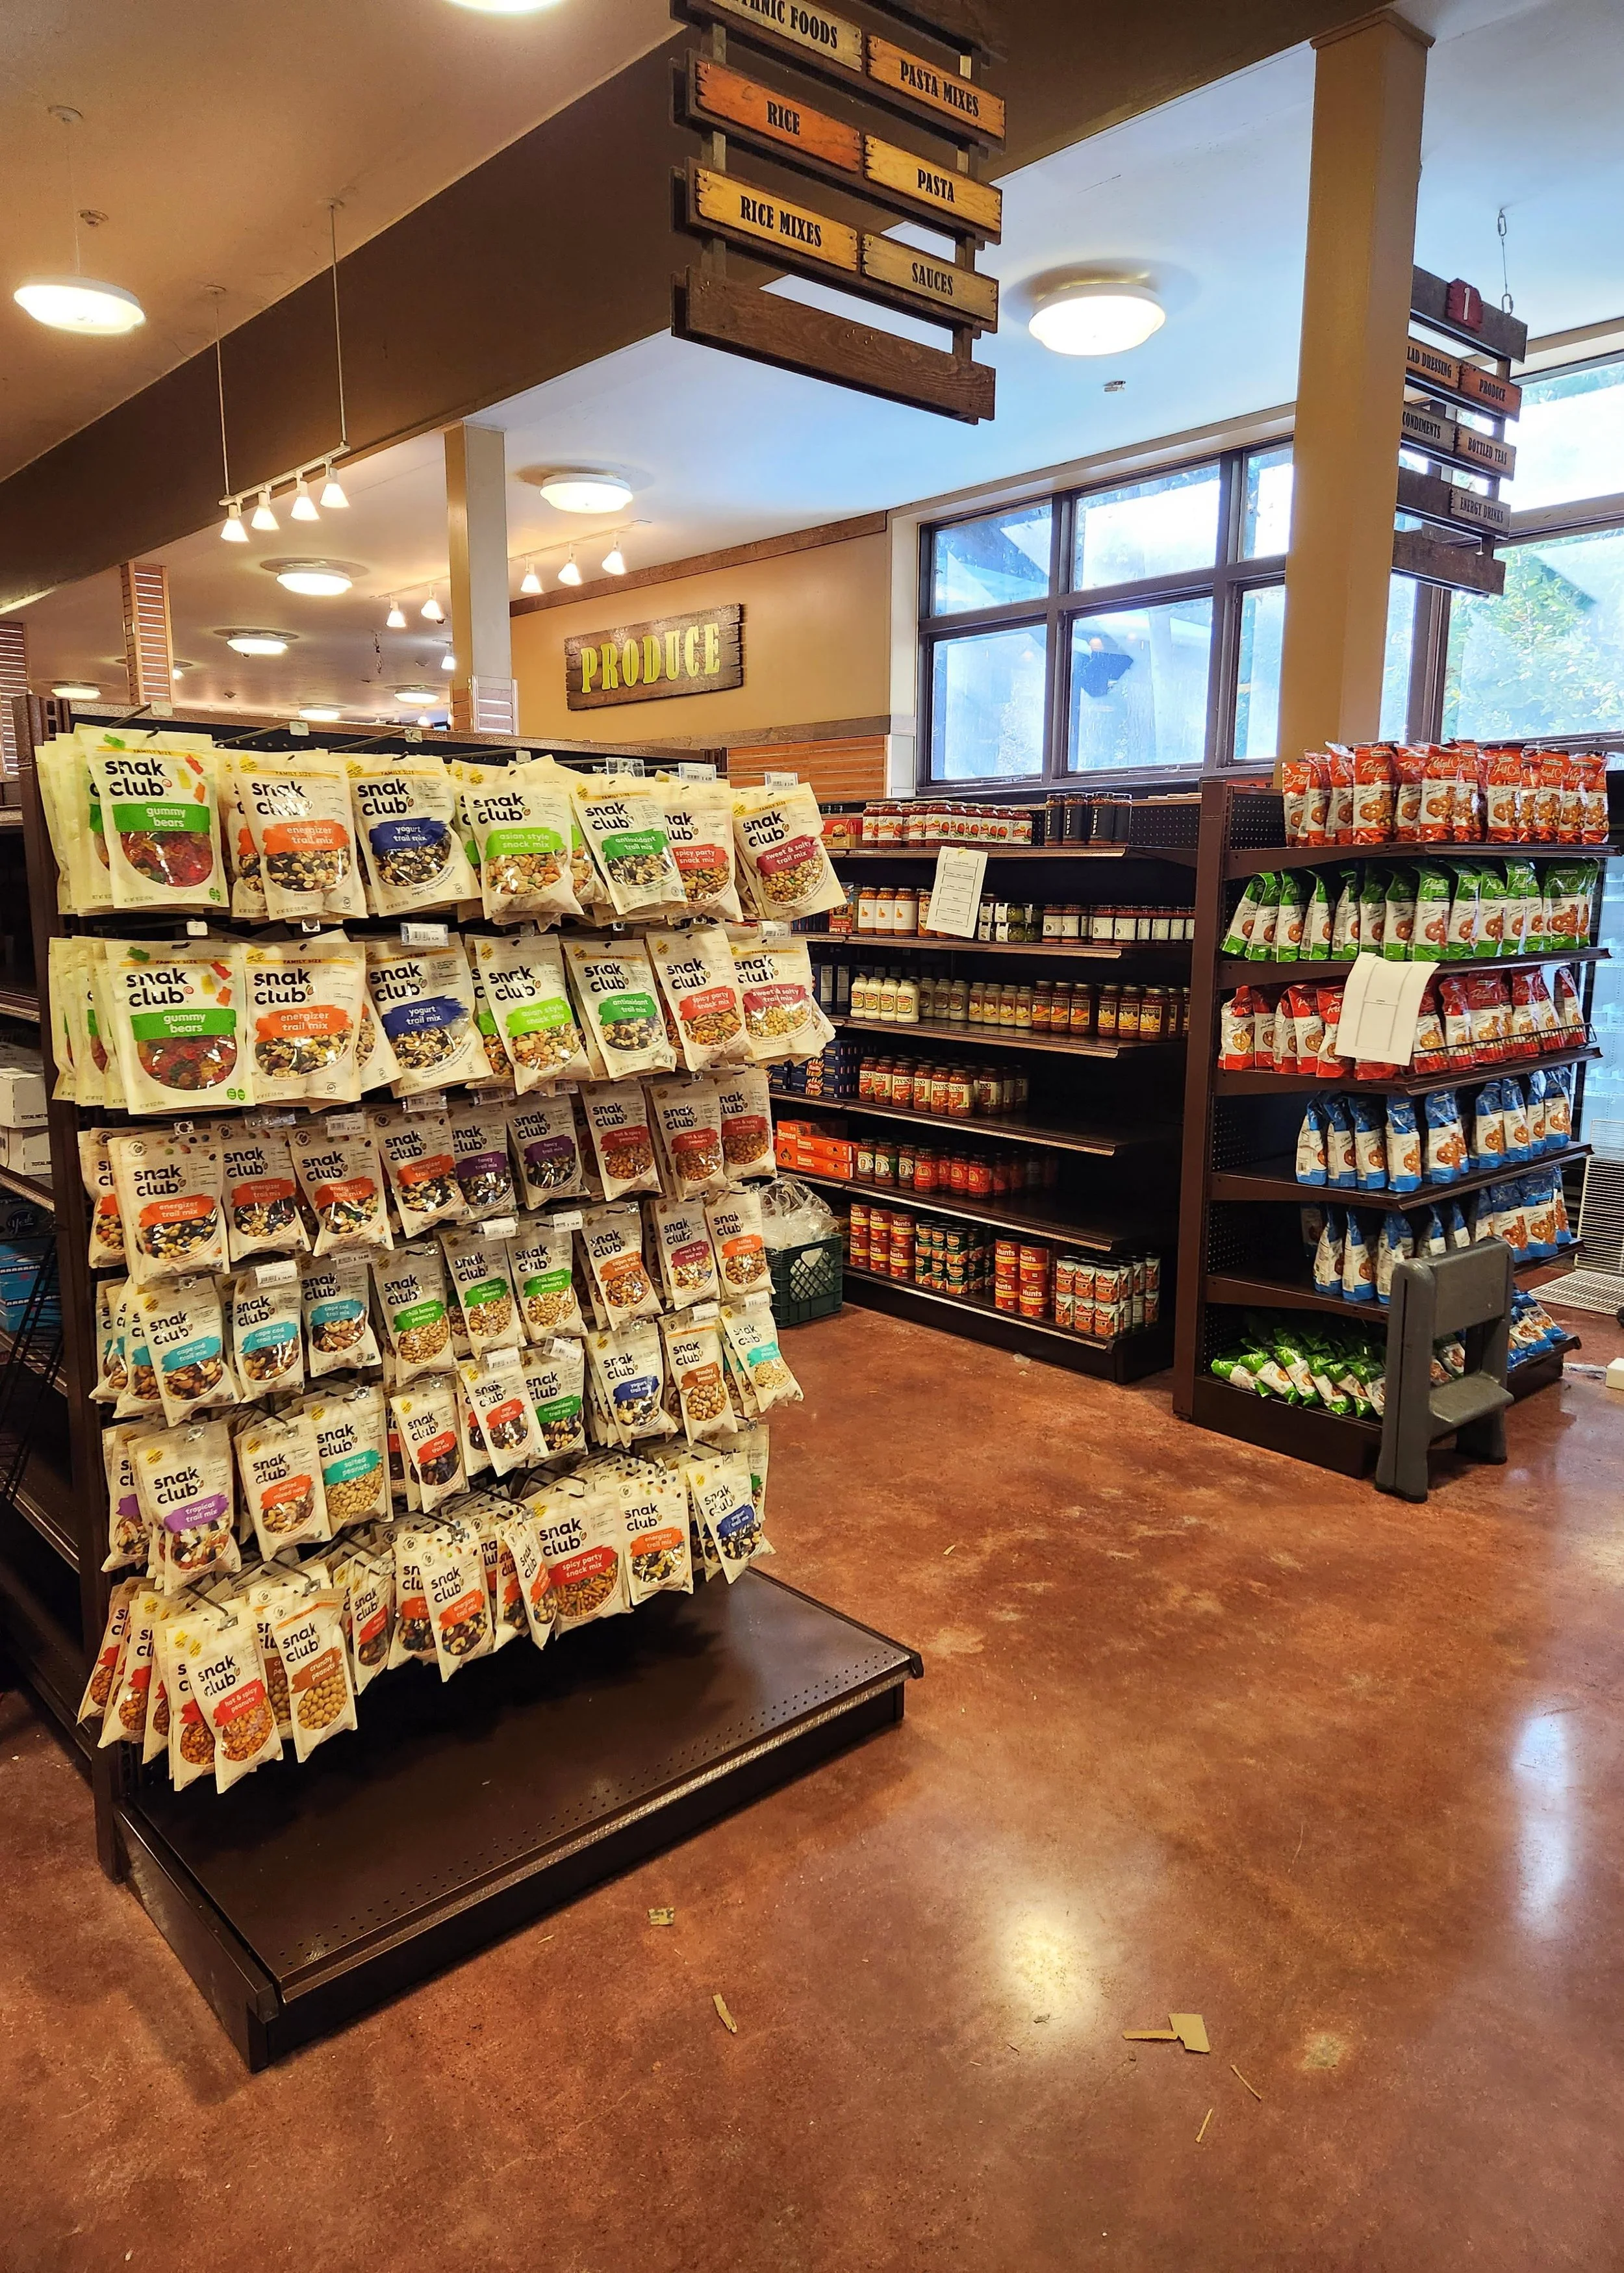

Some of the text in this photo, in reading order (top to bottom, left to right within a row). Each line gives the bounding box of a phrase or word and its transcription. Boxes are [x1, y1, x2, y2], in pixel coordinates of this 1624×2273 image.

[791, 6, 837, 49] FOODS
[900, 61, 979, 117] PASTA MIXES
[767, 101, 801, 136] RICE
[917, 168, 955, 203] PASTA
[740, 196, 822, 247] RICE MIXES
[911, 262, 953, 297] SAUCES
[1464, 287, 1471, 320] 1
[1422, 353, 1452, 379] DRESSING
[1479, 379, 1506, 401] PRODUCE
[1402, 412, 1440, 439] CONDIMENTS
[1468, 437, 1507, 465] BOTTLED TEAS
[1460, 497, 1503, 523] ENERGY DRINKS
[581, 623, 720, 694] PRODUCE
[105, 758, 166, 777] snak
[109, 778, 164, 796] club
[357, 779, 409, 798] snak
[362, 797, 407, 816] club
[473, 793, 525, 808] snak
[146, 807, 186, 818] gummy
[477, 807, 523, 824] club
[585, 802, 628, 817] snak
[153, 817, 184, 827] bears
[592, 815, 629, 831] club
[742, 811, 785, 833] snak
[286, 827, 333, 835] energizer
[615, 835, 656, 844] antioxidant
[748, 827, 785, 848] club
[675, 849, 715, 859] spicy party
[765, 848, 784, 860] sweet
[794, 841, 811, 854] salty
[776, 850, 807, 865] trail mix
[585, 962, 624, 978] snak
[666, 958, 706, 975] snak
[734, 956, 775, 971] snak
[126, 968, 188, 988] snak
[253, 968, 311, 985] snak
[370, 962, 424, 985] snak
[488, 965, 535, 985] snak
[590, 978, 626, 993] club
[672, 974, 706, 991] club
[129, 987, 185, 1007] club
[254, 987, 307, 1005] club
[374, 982, 420, 1002] club
[495, 984, 536, 1001] club
[692, 991, 729, 1004] spicy party
[408, 1006, 437, 1017] yogurt
[697, 1001, 717, 1010] snack
[163, 1013, 206, 1024] gummy
[280, 1011, 329, 1022] energizer
[426, 1014, 442, 1022] mix
[170, 1023, 203, 1033] bears
[282, 1021, 329, 1030] trail mix
[592, 1102, 624, 1115] snak
[595, 1113, 624, 1127] club
[778, 1129, 796, 1139] Banza
[301, 1150, 345, 1169] snak
[134, 1164, 183, 1182] snak
[306, 1165, 344, 1182] club
[136, 1180, 179, 1197] club
[159, 1201, 198, 1210] energizer
[418, 1304, 437, 1315] lemon
[411, 1313, 435, 1324] peanuts
[344, 1456, 366, 1467] salted
[153, 1466, 200, 1490] snak
[342, 1464, 370, 1477] peanuts
[157, 1484, 198, 1505] club
[185, 1501, 216, 1515] tropical
[186, 1509, 218, 1523] trail mix
[539, 1517, 583, 1542] snak
[644, 1532, 672, 1542] energizer
[542, 1536, 582, 1557] club
[562, 1553, 603, 1571] spicy party
[566, 1560, 602, 1579] snack mix
[197, 1655, 236, 1683] snak
[309, 1655, 333, 1674] crunchy
[311, 1663, 336, 1682] peanuts
[203, 1673, 236, 1697] club
[224, 1697, 236, 1707] hot
[242, 1687, 257, 1700] spicy
[230, 1697, 255, 1713] peanuts
